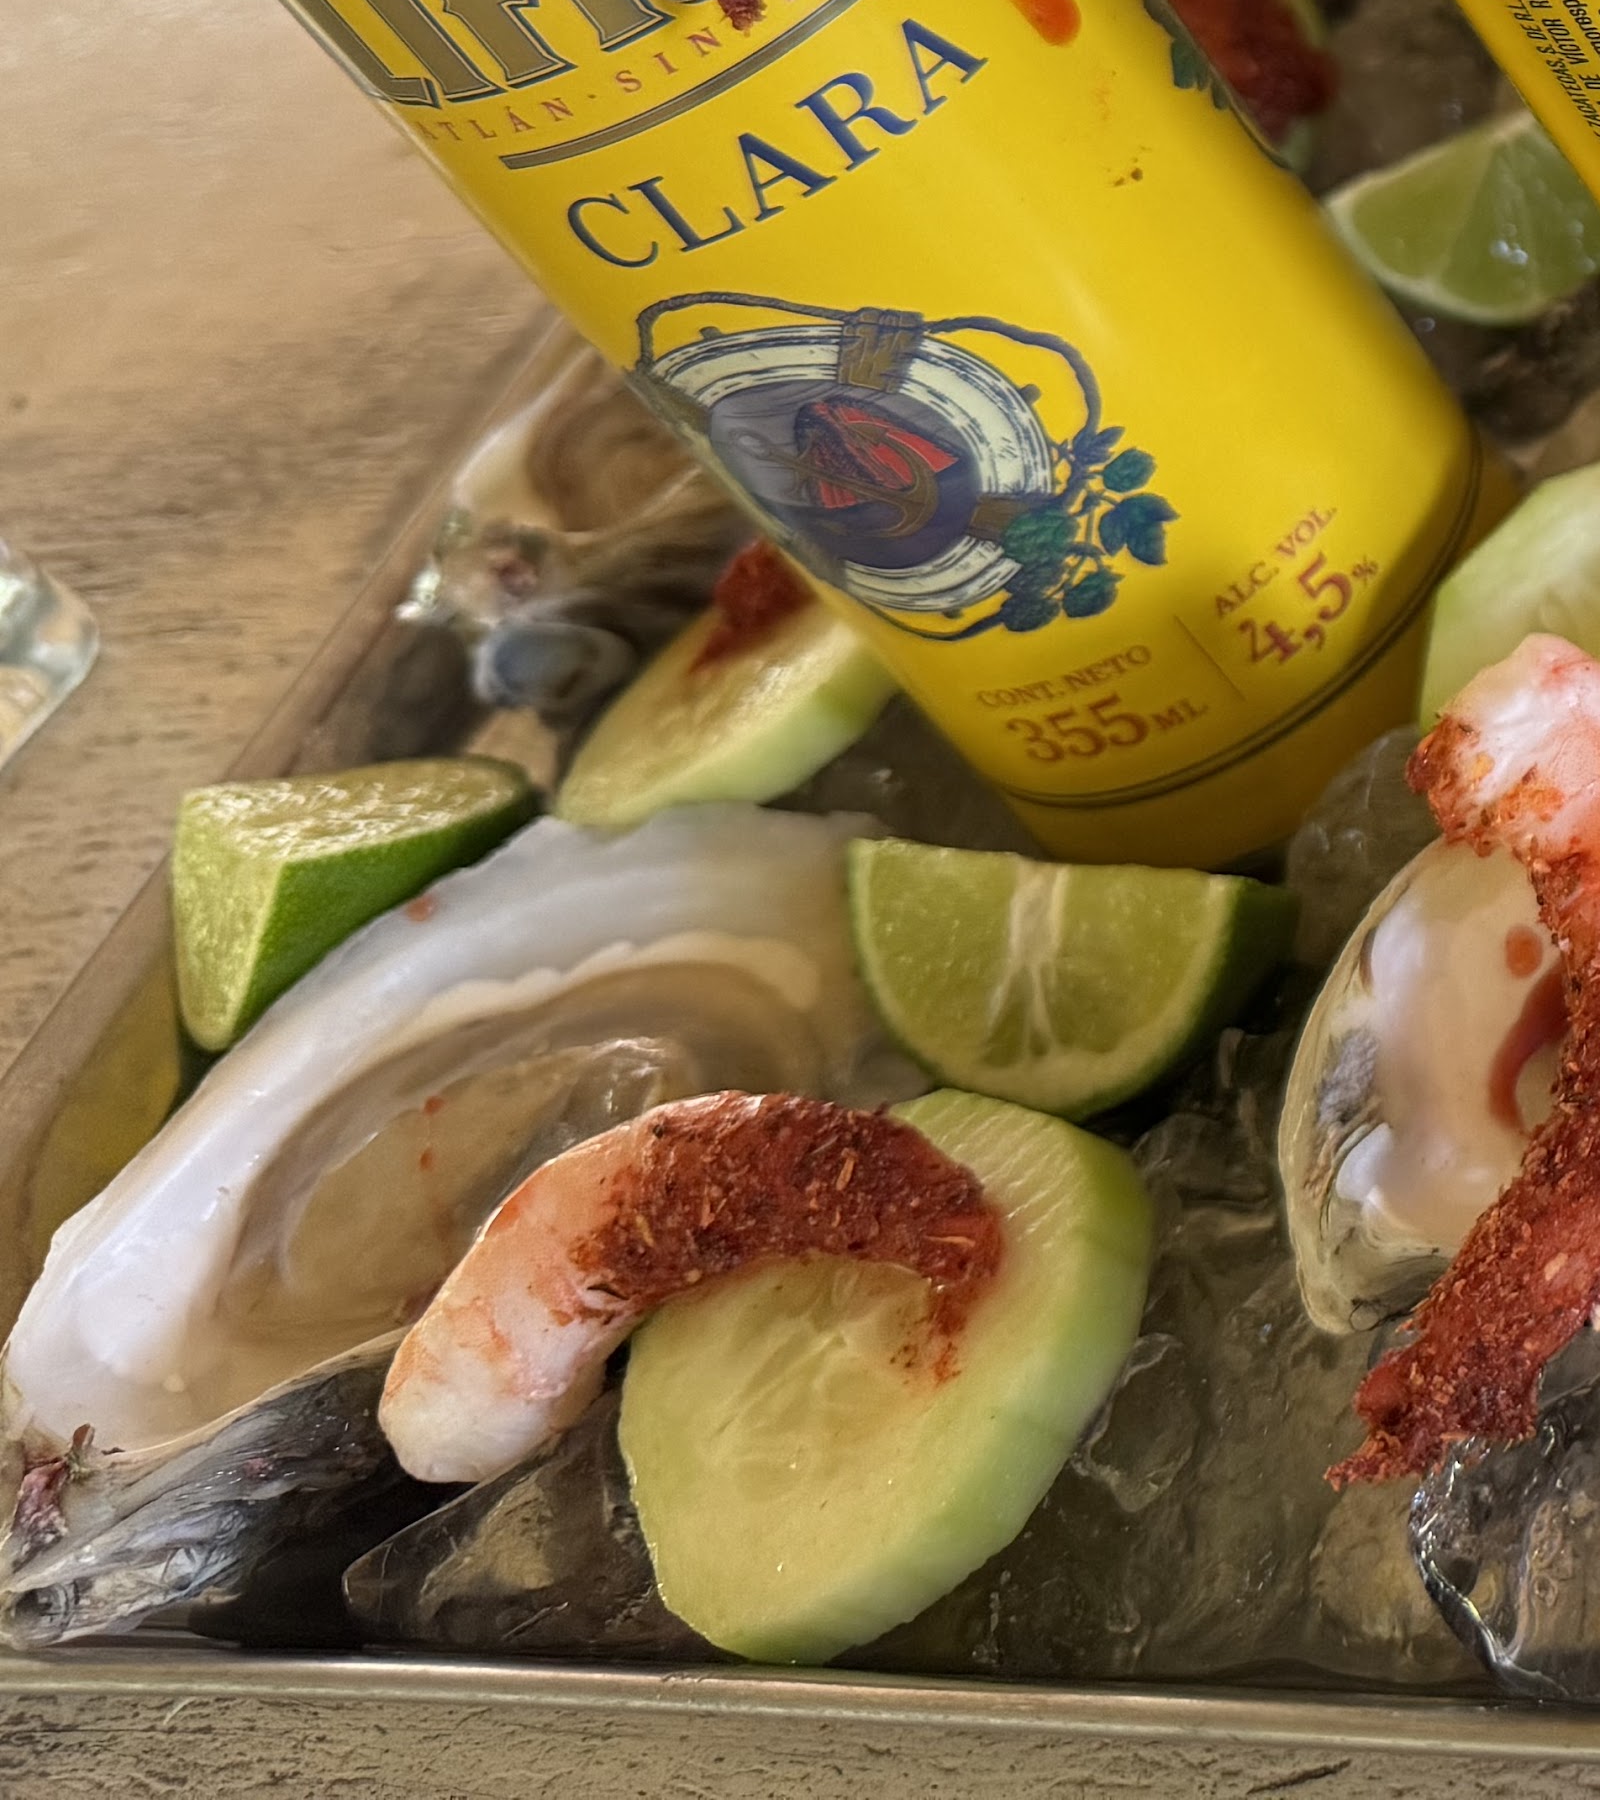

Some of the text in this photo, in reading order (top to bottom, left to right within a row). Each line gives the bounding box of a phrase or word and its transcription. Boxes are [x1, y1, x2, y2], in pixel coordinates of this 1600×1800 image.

[1521, 23, 1548, 43] DE
[565, 16, 989, 268] CLARA
[1213, 507, 1337, 620] ALC. VOL.
[976, 644, 1153, 710] CONT. NETO
